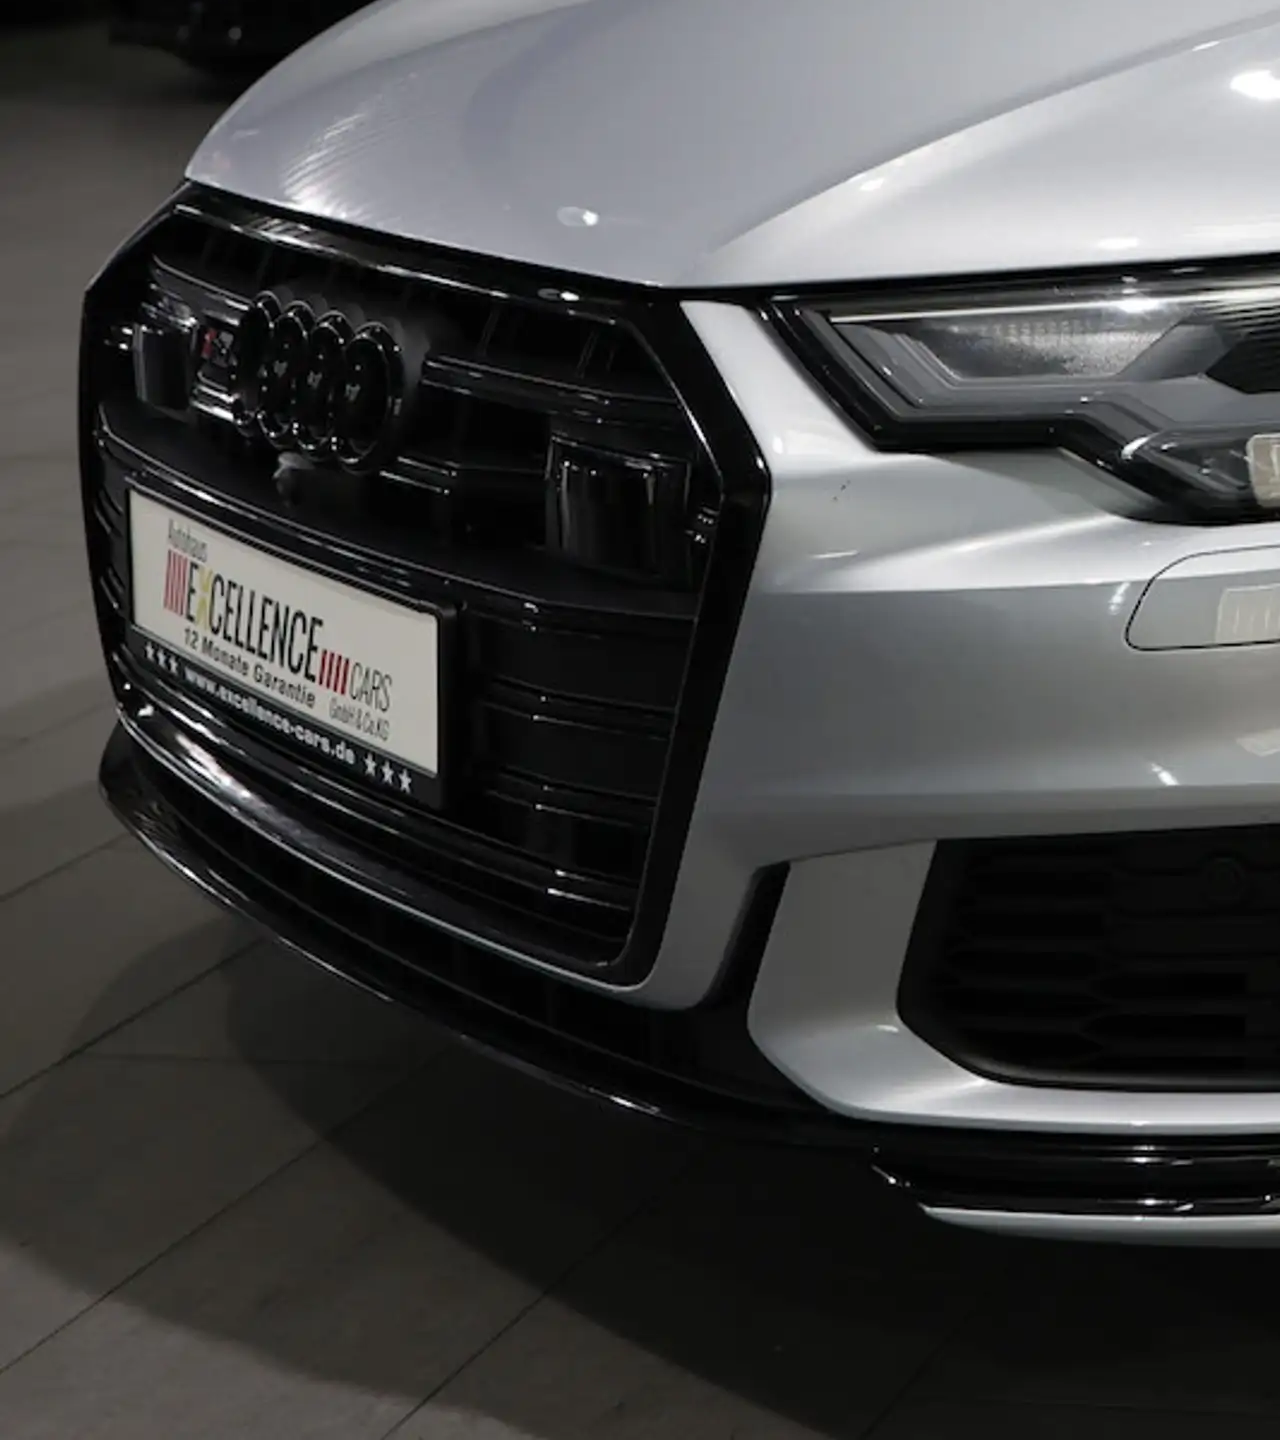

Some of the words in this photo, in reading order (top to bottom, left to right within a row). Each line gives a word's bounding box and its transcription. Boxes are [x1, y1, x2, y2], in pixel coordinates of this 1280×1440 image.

[184, 627, 199, 650] 12
[202, 636, 249, 677] Monate
[253, 664, 316, 709] Garantie
[186, 560, 324, 682] EXCELLENCE
[349, 662, 393, 713] CARS
